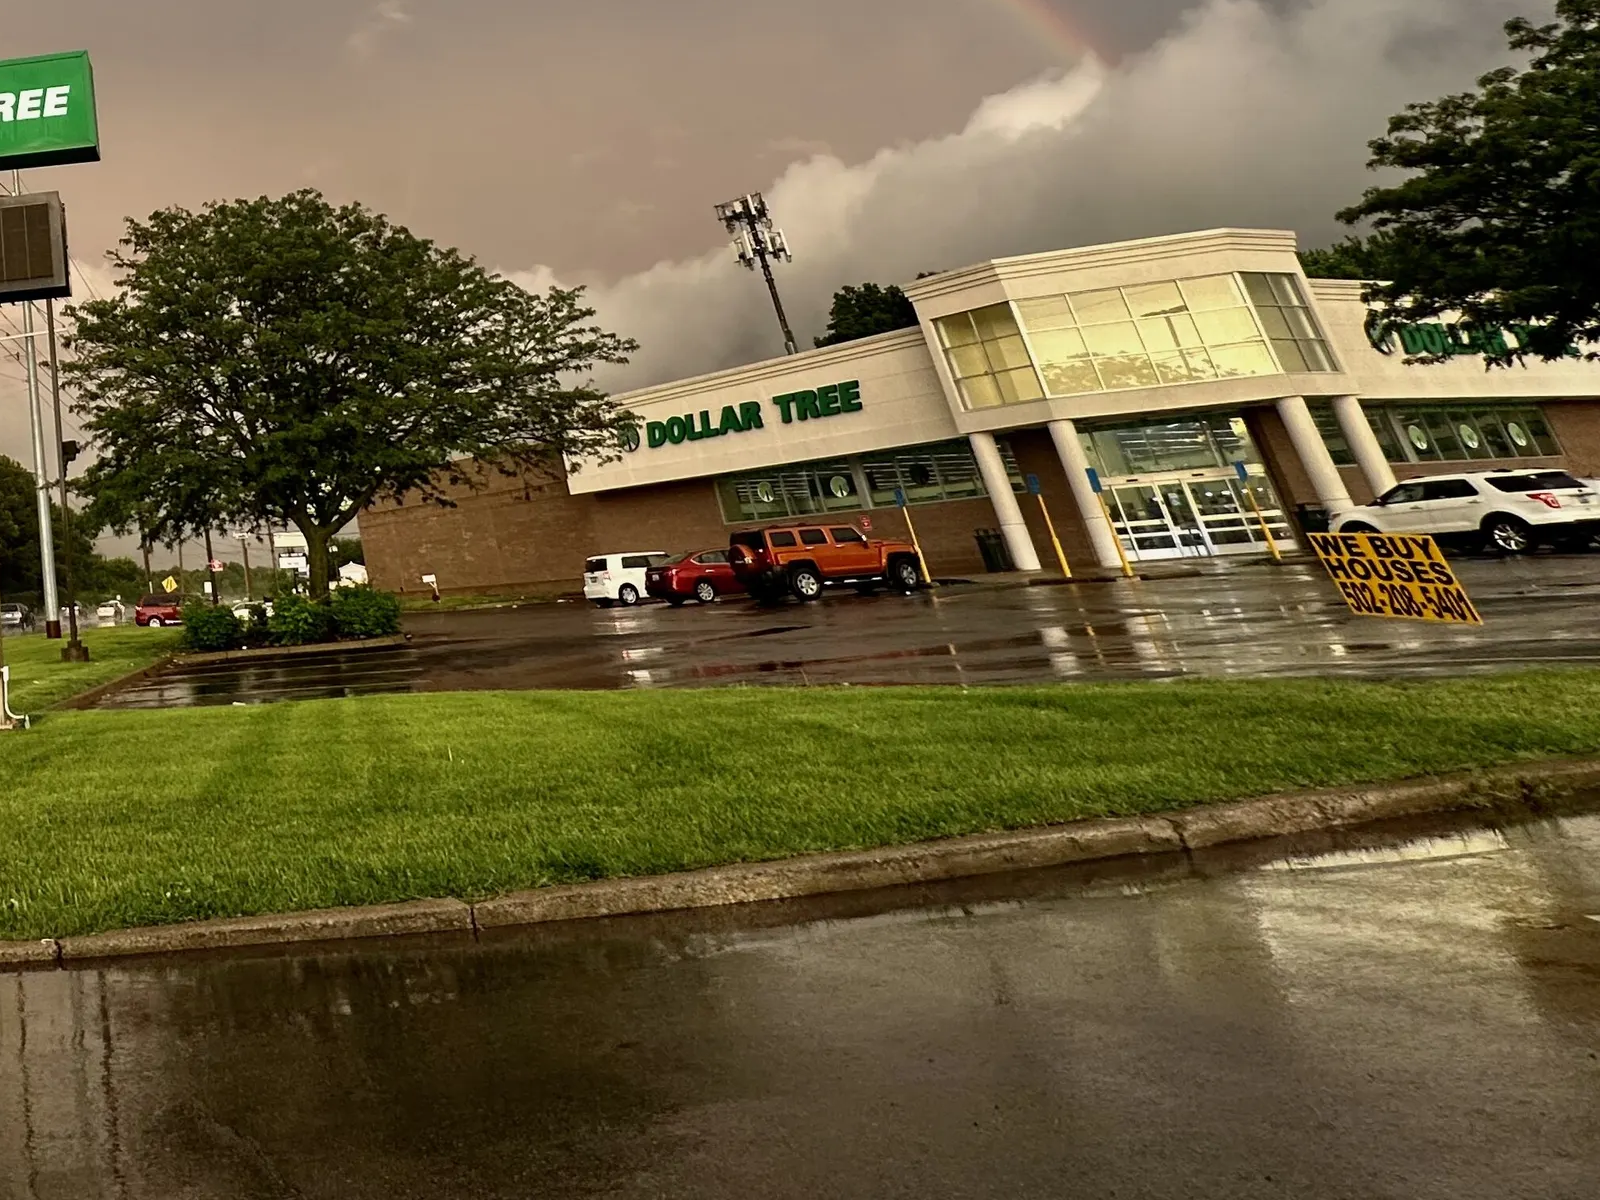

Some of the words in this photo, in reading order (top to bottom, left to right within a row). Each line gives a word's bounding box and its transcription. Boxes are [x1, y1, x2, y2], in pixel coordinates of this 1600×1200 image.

[646, 401, 763, 448] DOLLAR
[773, 380, 862, 423] TREE
[1311, 535, 1366, 557] WE
[1367, 536, 1435, 560] BUY
[1323, 558, 1455, 585] HOUSES
